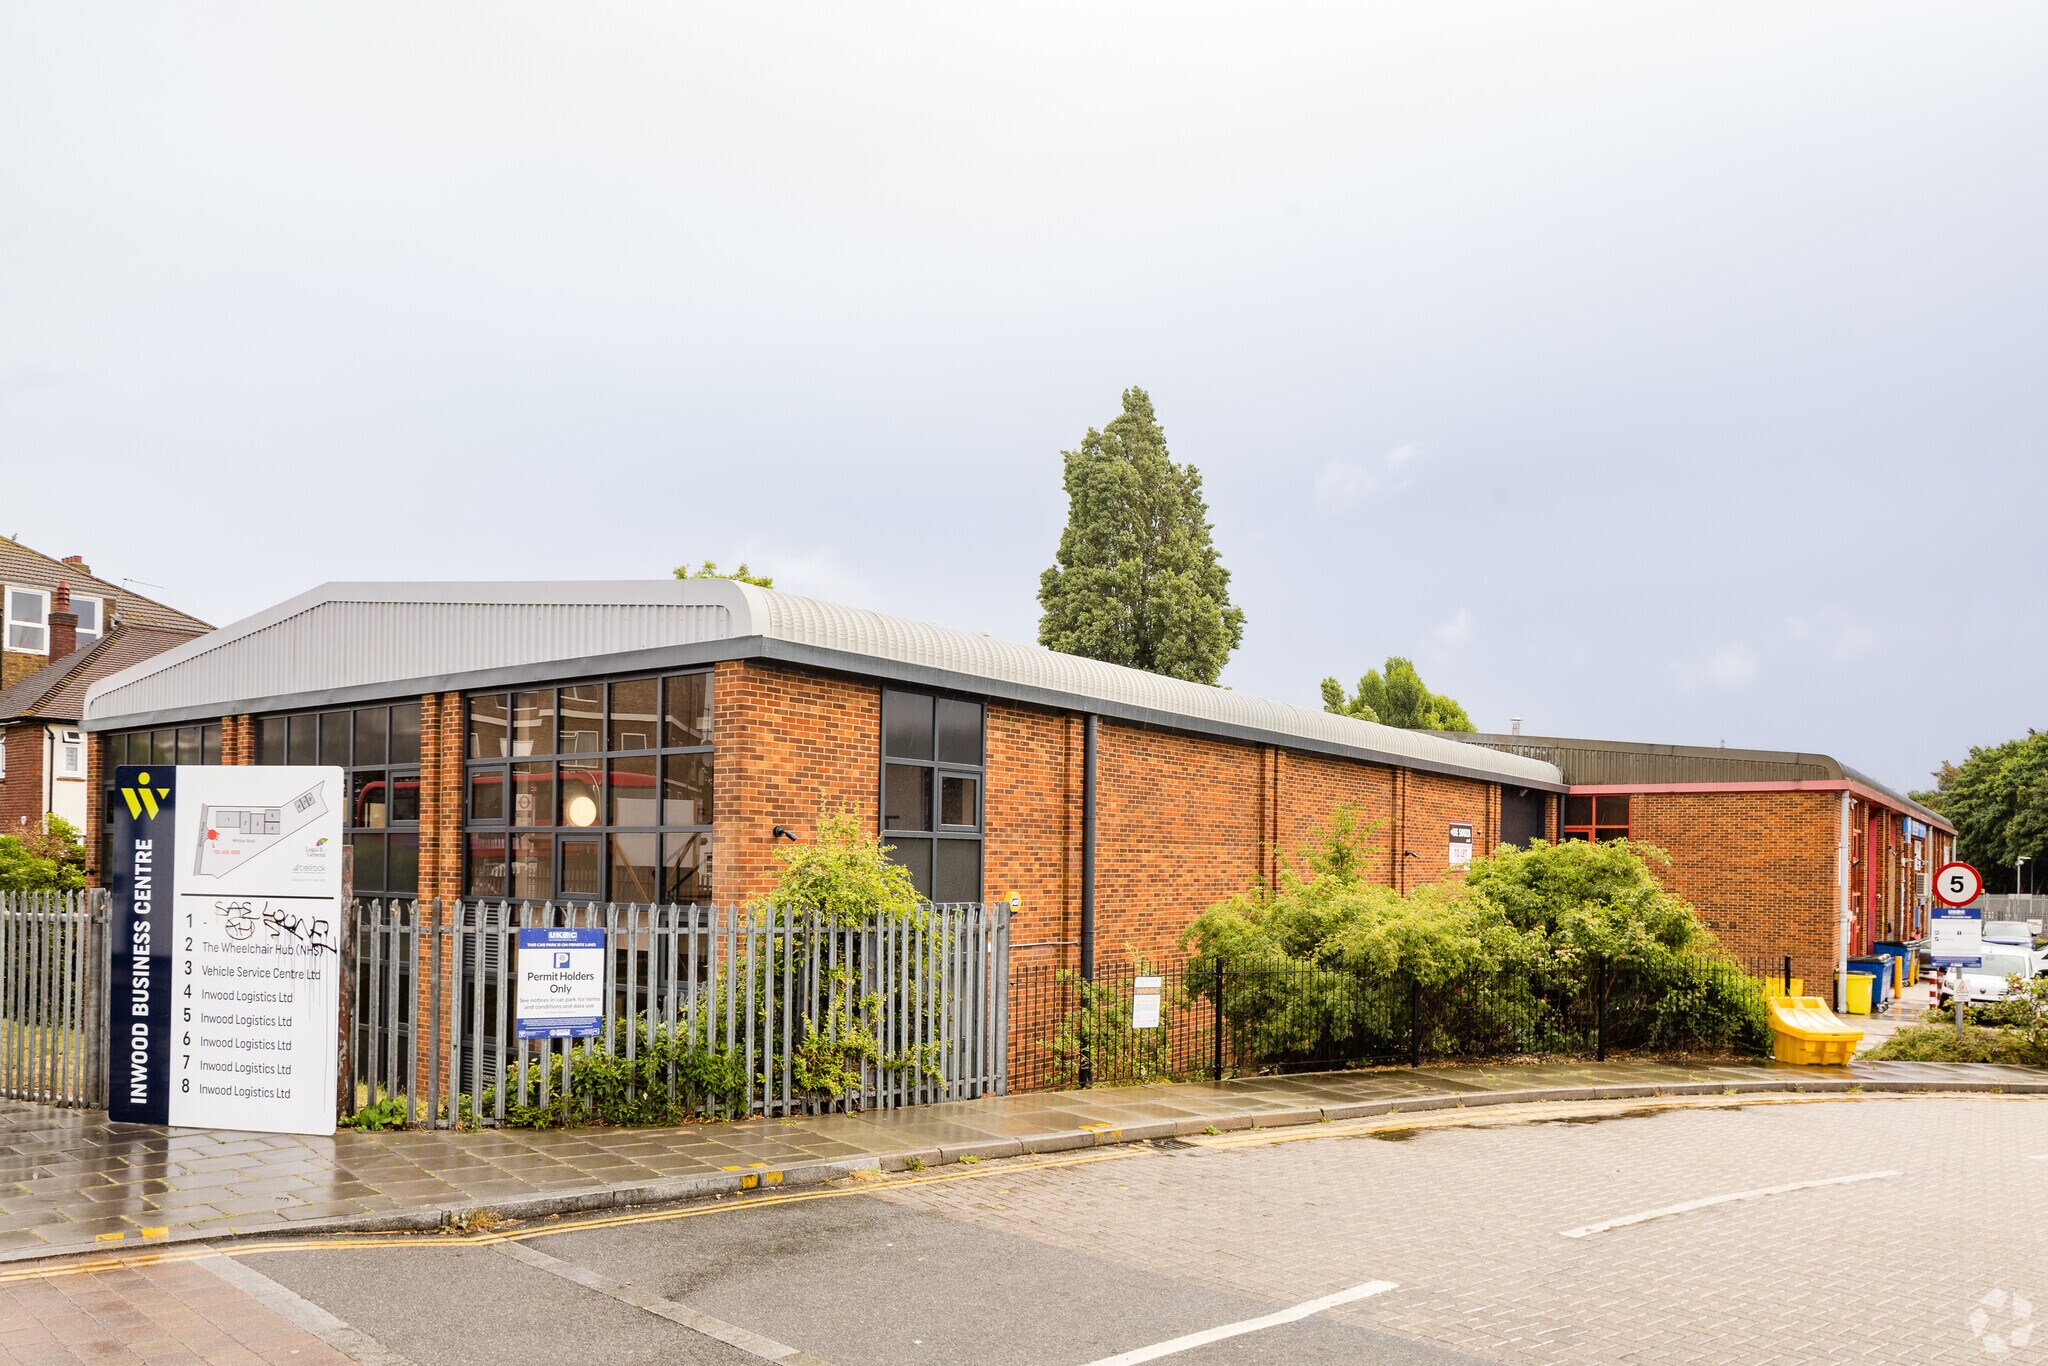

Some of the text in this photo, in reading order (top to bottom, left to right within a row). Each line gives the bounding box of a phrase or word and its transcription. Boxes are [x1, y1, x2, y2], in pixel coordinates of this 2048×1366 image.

[134, 839, 153, 915] CENTRE
[1950, 876, 1964, 893] 5
[186, 913, 193, 928] 1
[185, 937, 323, 957] 2 The Wheelchair Hub (NHS)
[132, 920, 151, 1017] BUSINESS
[185, 960, 321, 980] 3 Vehicle Service Centre Ltd
[527, 972, 594, 981] Permit Holders
[183, 984, 293, 1004] 4 Inwood Logistics Ltd
[550, 984, 572, 995] Only
[183, 1007, 292, 1027] 5 Inwood Logistics Ltd
[182, 1031, 292, 1051] 6 Inwood Logistics Ltd
[130, 1022, 149, 1104] INWOOD
[182, 1054, 292, 1075] 7 Inwood Logistics Ltd
[181, 1078, 291, 1099] 8 Inwood Logistics Ltd
